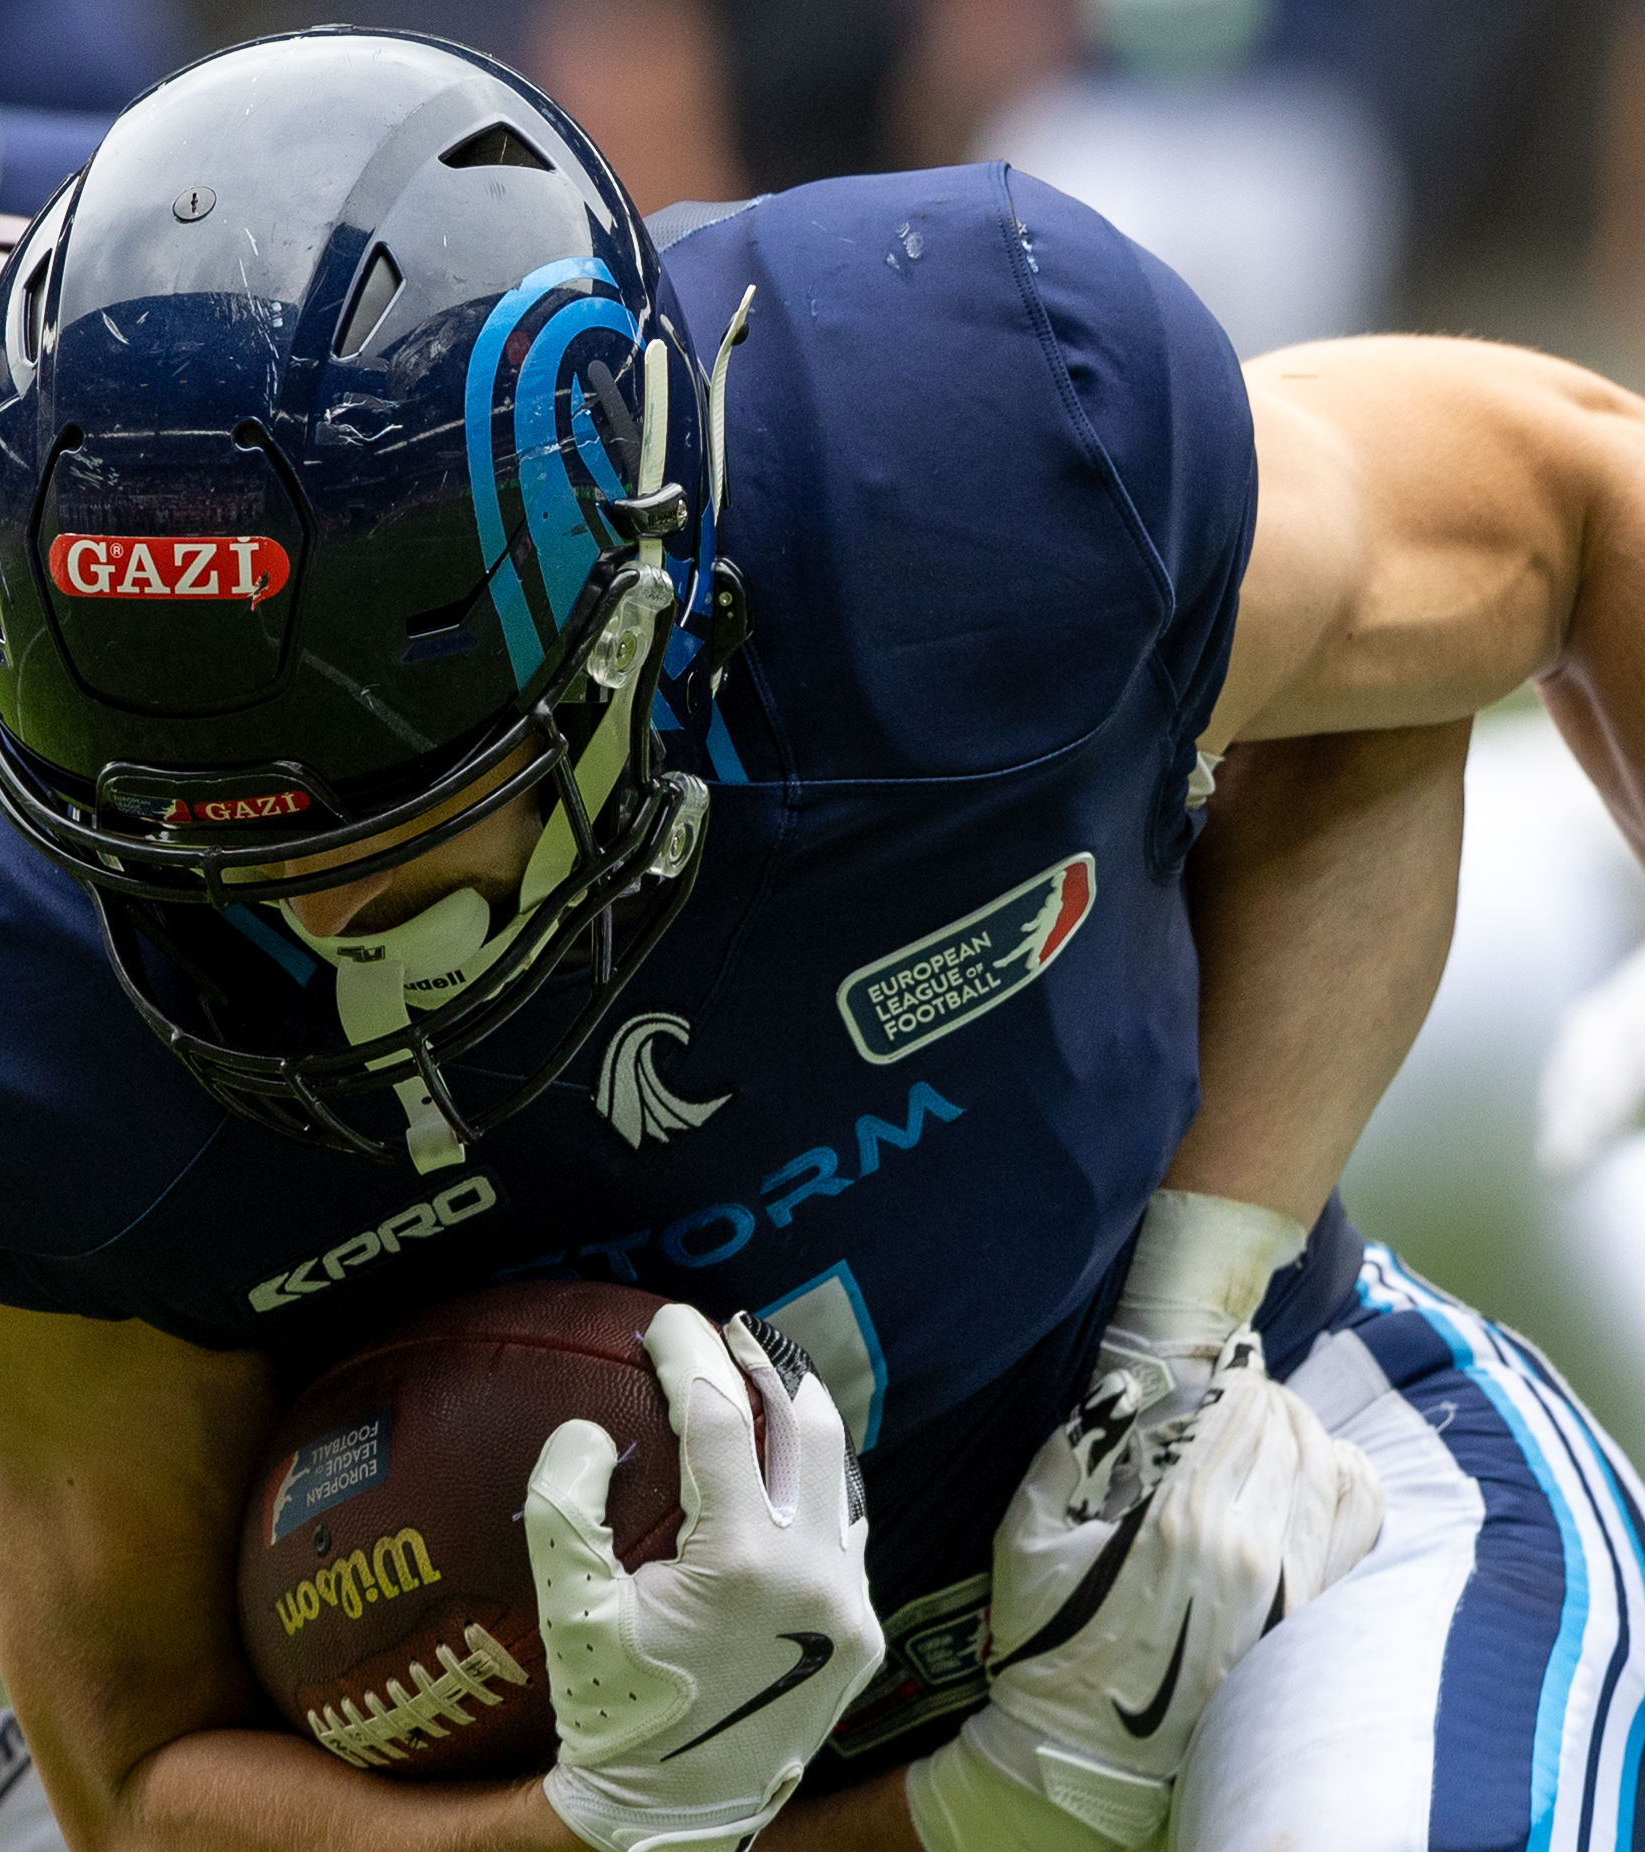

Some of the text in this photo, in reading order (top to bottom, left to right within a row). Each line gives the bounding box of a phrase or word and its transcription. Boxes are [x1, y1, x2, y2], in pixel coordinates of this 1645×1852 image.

[867, 931, 992, 1003] EUROPEAN
[875, 962, 985, 1022] LEAGUE OF
[883, 972, 1002, 1041] FOOTBALL
[311, 1420, 380, 1465] FOOTBALL
[325, 1439, 378, 1477] LEAGUE
[306, 1458, 378, 1507] EUROPEAN
[274, 1527, 442, 1636] Wilson
